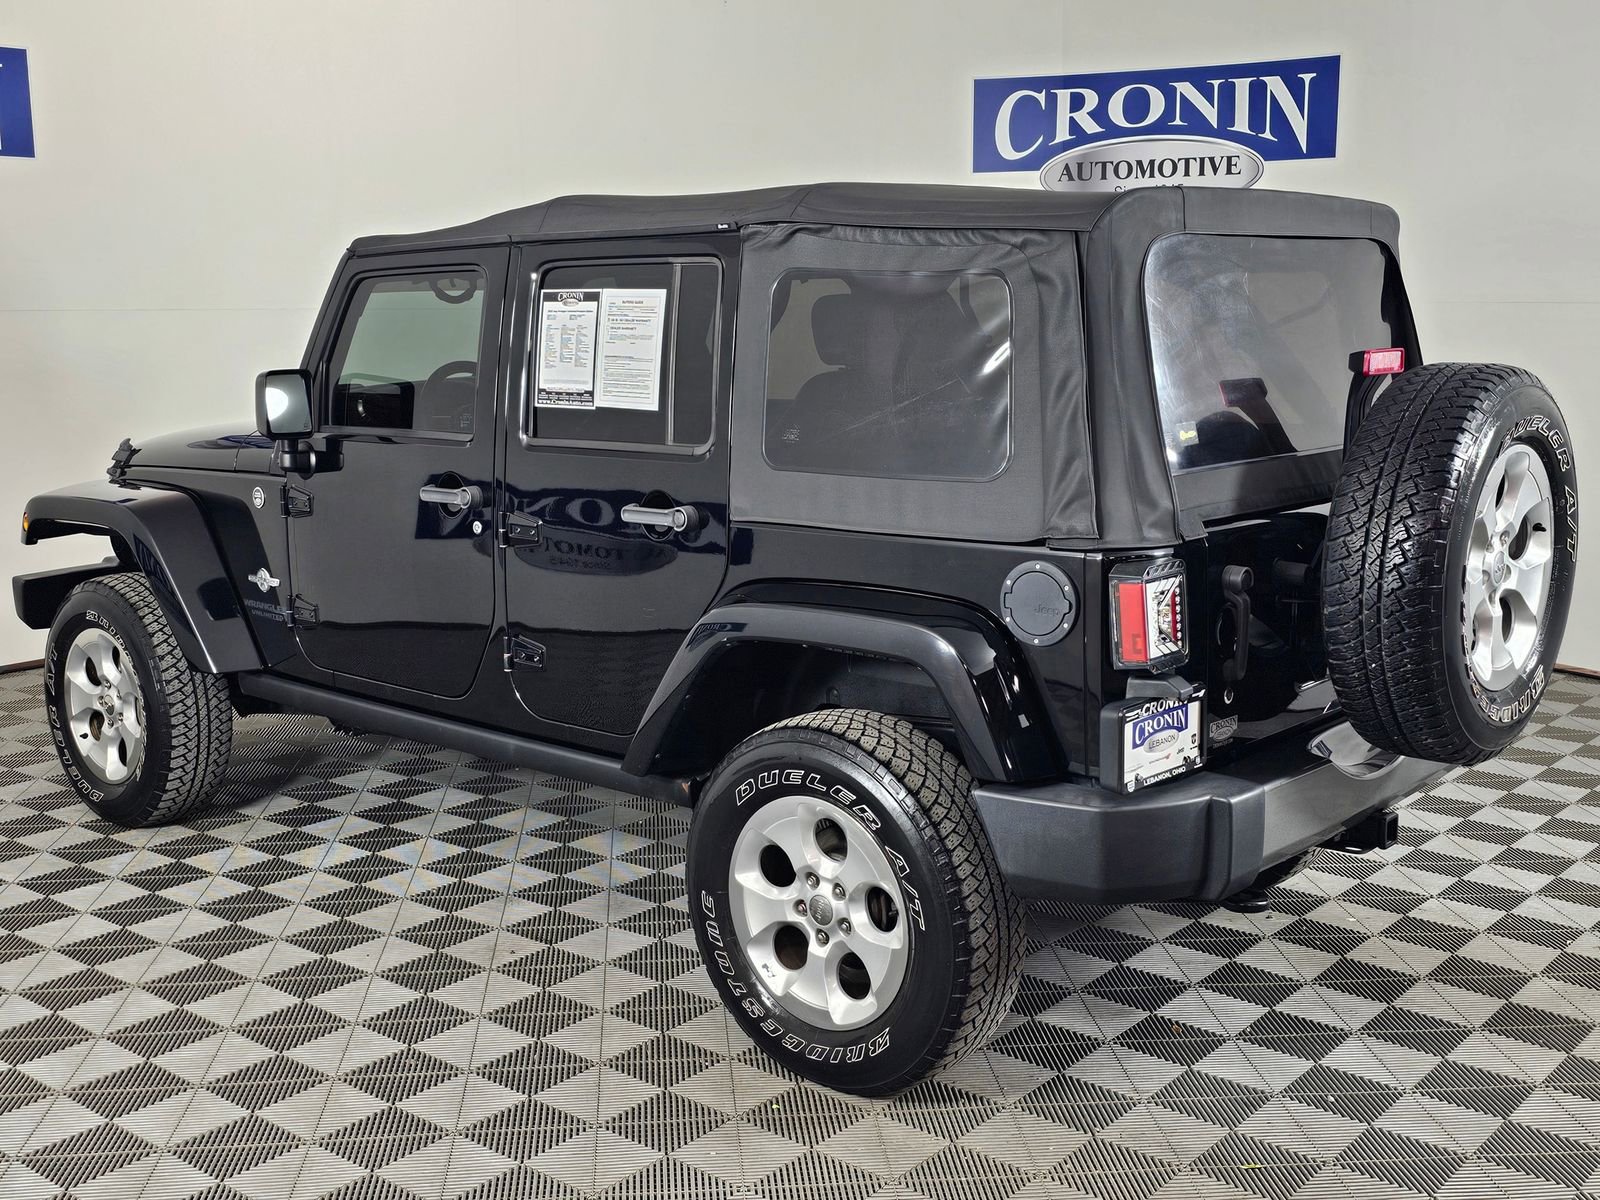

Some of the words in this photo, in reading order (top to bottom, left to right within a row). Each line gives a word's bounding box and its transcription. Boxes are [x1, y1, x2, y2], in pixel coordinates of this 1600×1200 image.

[994, 72, 1317, 161] CRONIN
[1057, 155, 1242, 183] AUTOMOTIVE
[557, 292, 584, 302] CRONIN
[1500, 415, 1572, 472] DUELER
[1554, 485, 1578, 563] A/T
[1033, 603, 1061, 617] Jeep
[1135, 706, 1187, 745] CRONIN
[1149, 734, 1176, 750] LEBANON
[1211, 717, 1236, 733] CRONIN
[1143, 771, 1172, 786] LEBANON,
[1172, 766, 1187, 776] OHIO
[735, 769, 881, 831] DUELER
[885, 846, 926, 931] A/T
[701, 890, 891, 1064] BRIDGESTONE
